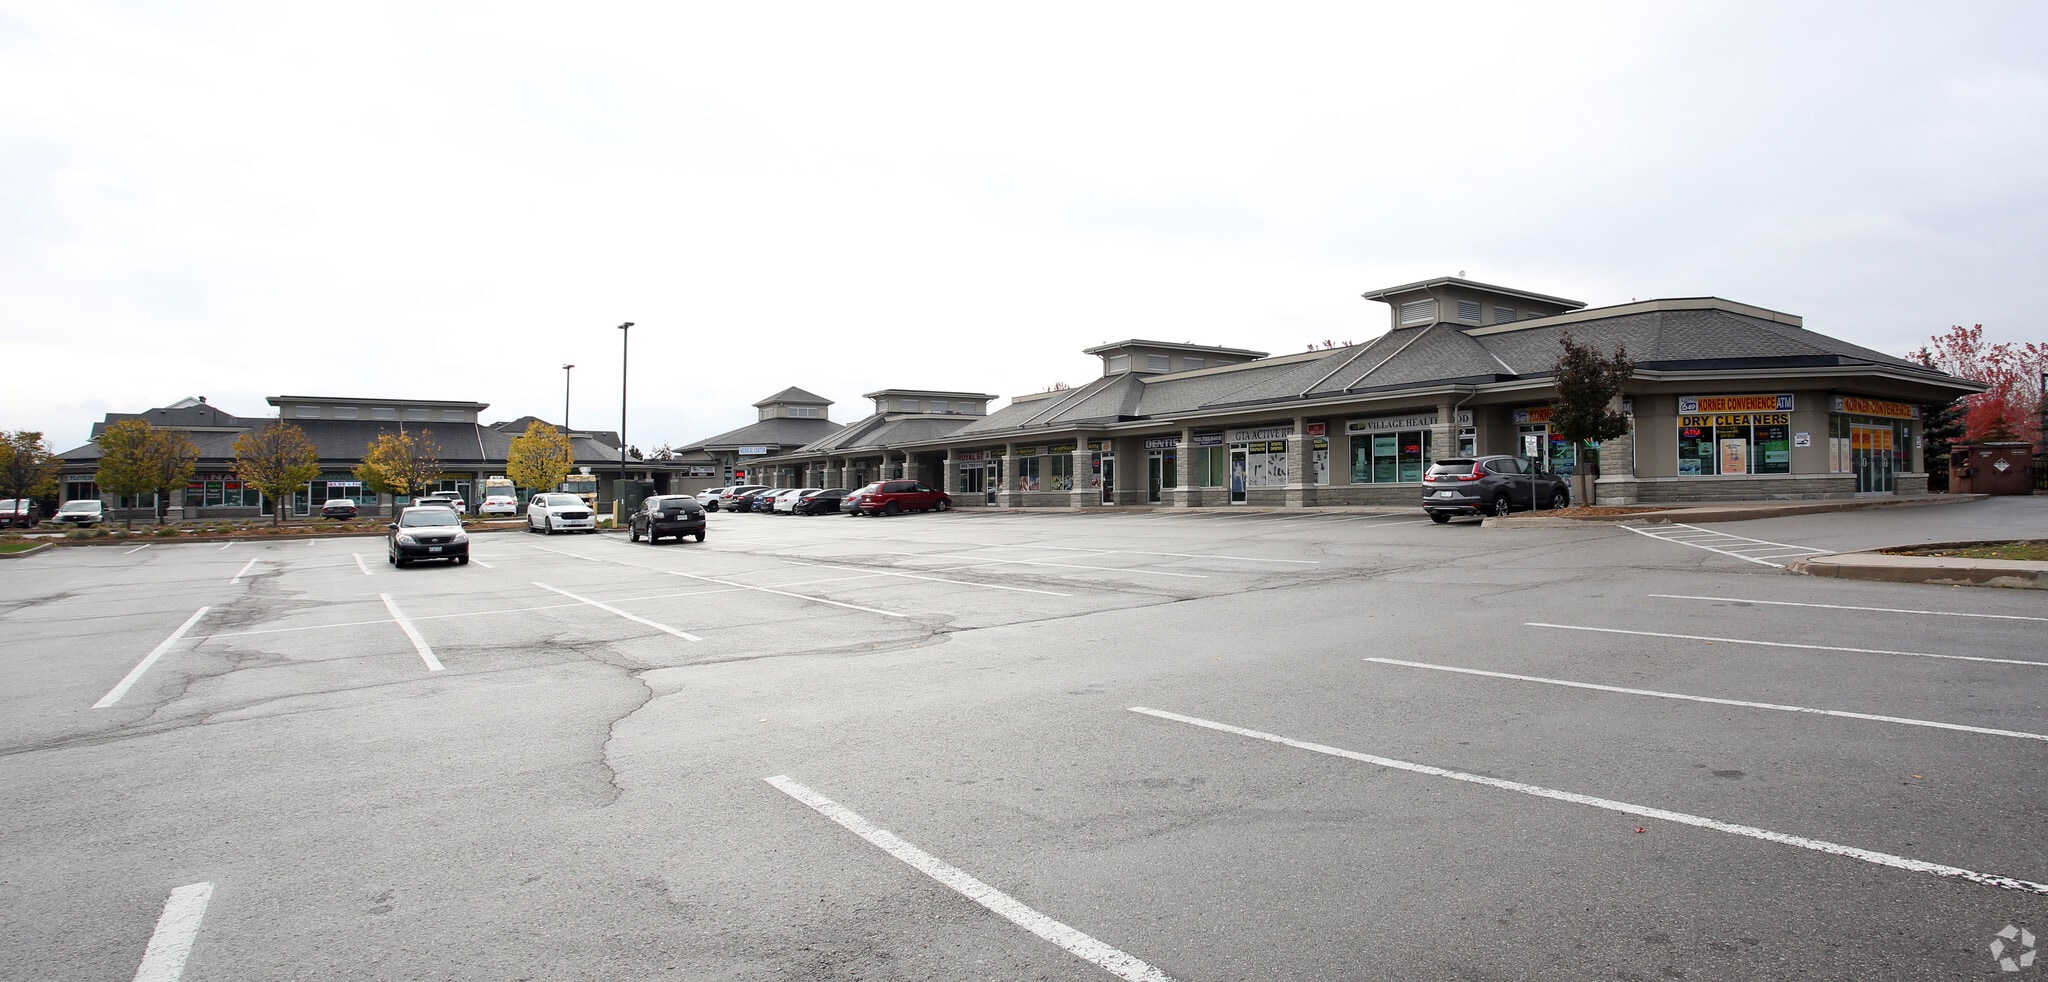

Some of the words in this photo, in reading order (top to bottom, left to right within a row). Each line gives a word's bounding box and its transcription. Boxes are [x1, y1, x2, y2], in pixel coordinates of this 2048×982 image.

[1698, 397, 1726, 412] KORNER
[1727, 396, 1775, 410] CONVENIENCE
[1776, 397, 1792, 409] ATM
[1845, 398, 1870, 412] KORNER
[1368, 420, 1404, 429] VILLAGE
[1683, 416, 1709, 426] DRY
[1715, 414, 1788, 426] CLEANERS
[1235, 431, 1251, 441] GTA
[1252, 428, 1280, 439] ACTIVE
